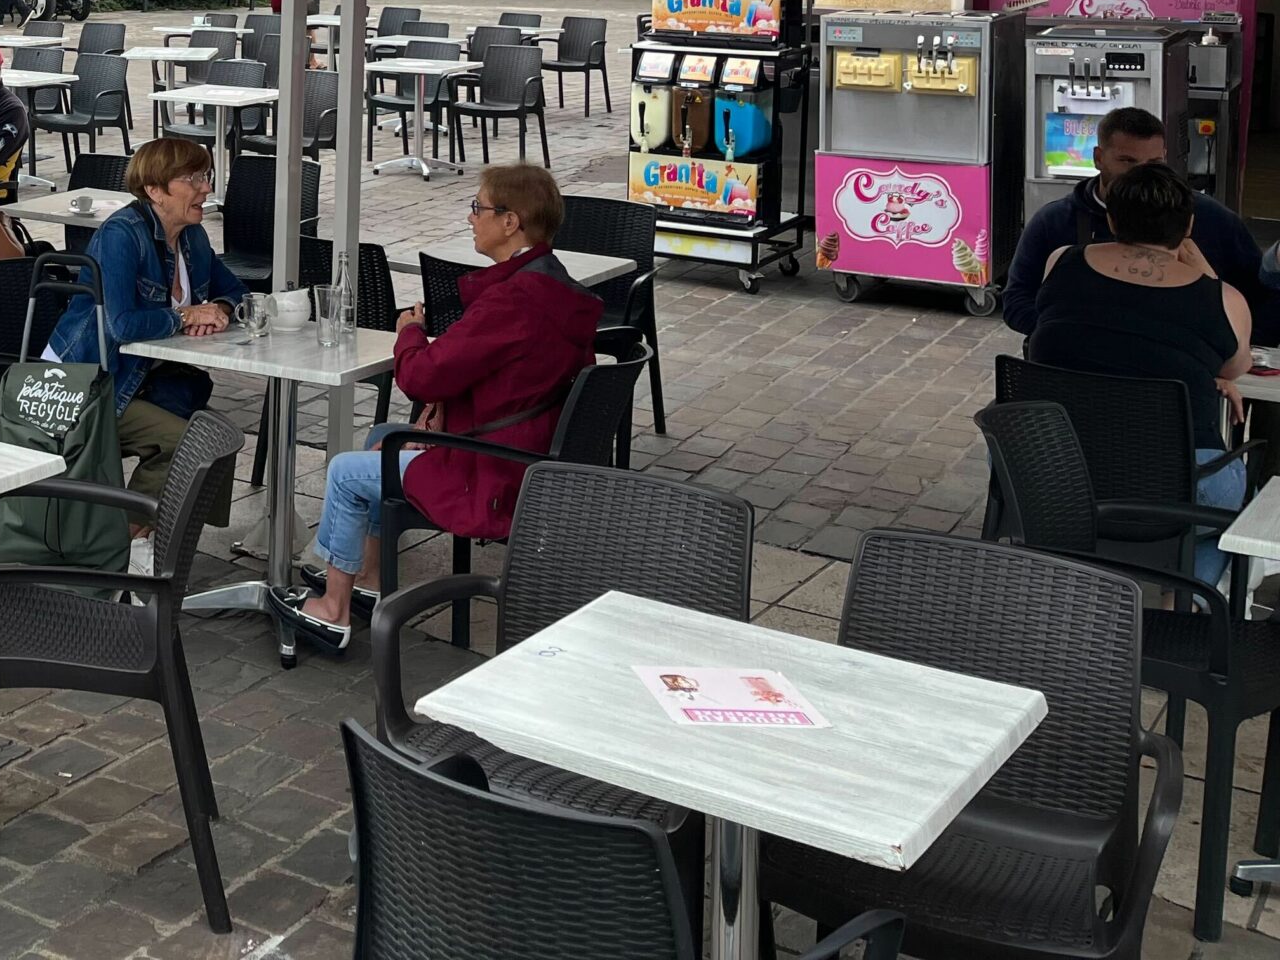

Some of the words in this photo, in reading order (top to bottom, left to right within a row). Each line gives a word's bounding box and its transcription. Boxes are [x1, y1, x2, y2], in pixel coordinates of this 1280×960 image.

[643, 160, 718, 194] Granita
[853, 173, 948, 208] Candy's
[870, 212, 933, 241] Coffee
[16, 381, 84, 406] plastique
[19, 399, 81, 422] RECYCLÉ
[696, 714, 802, 724] NOUVEAU
